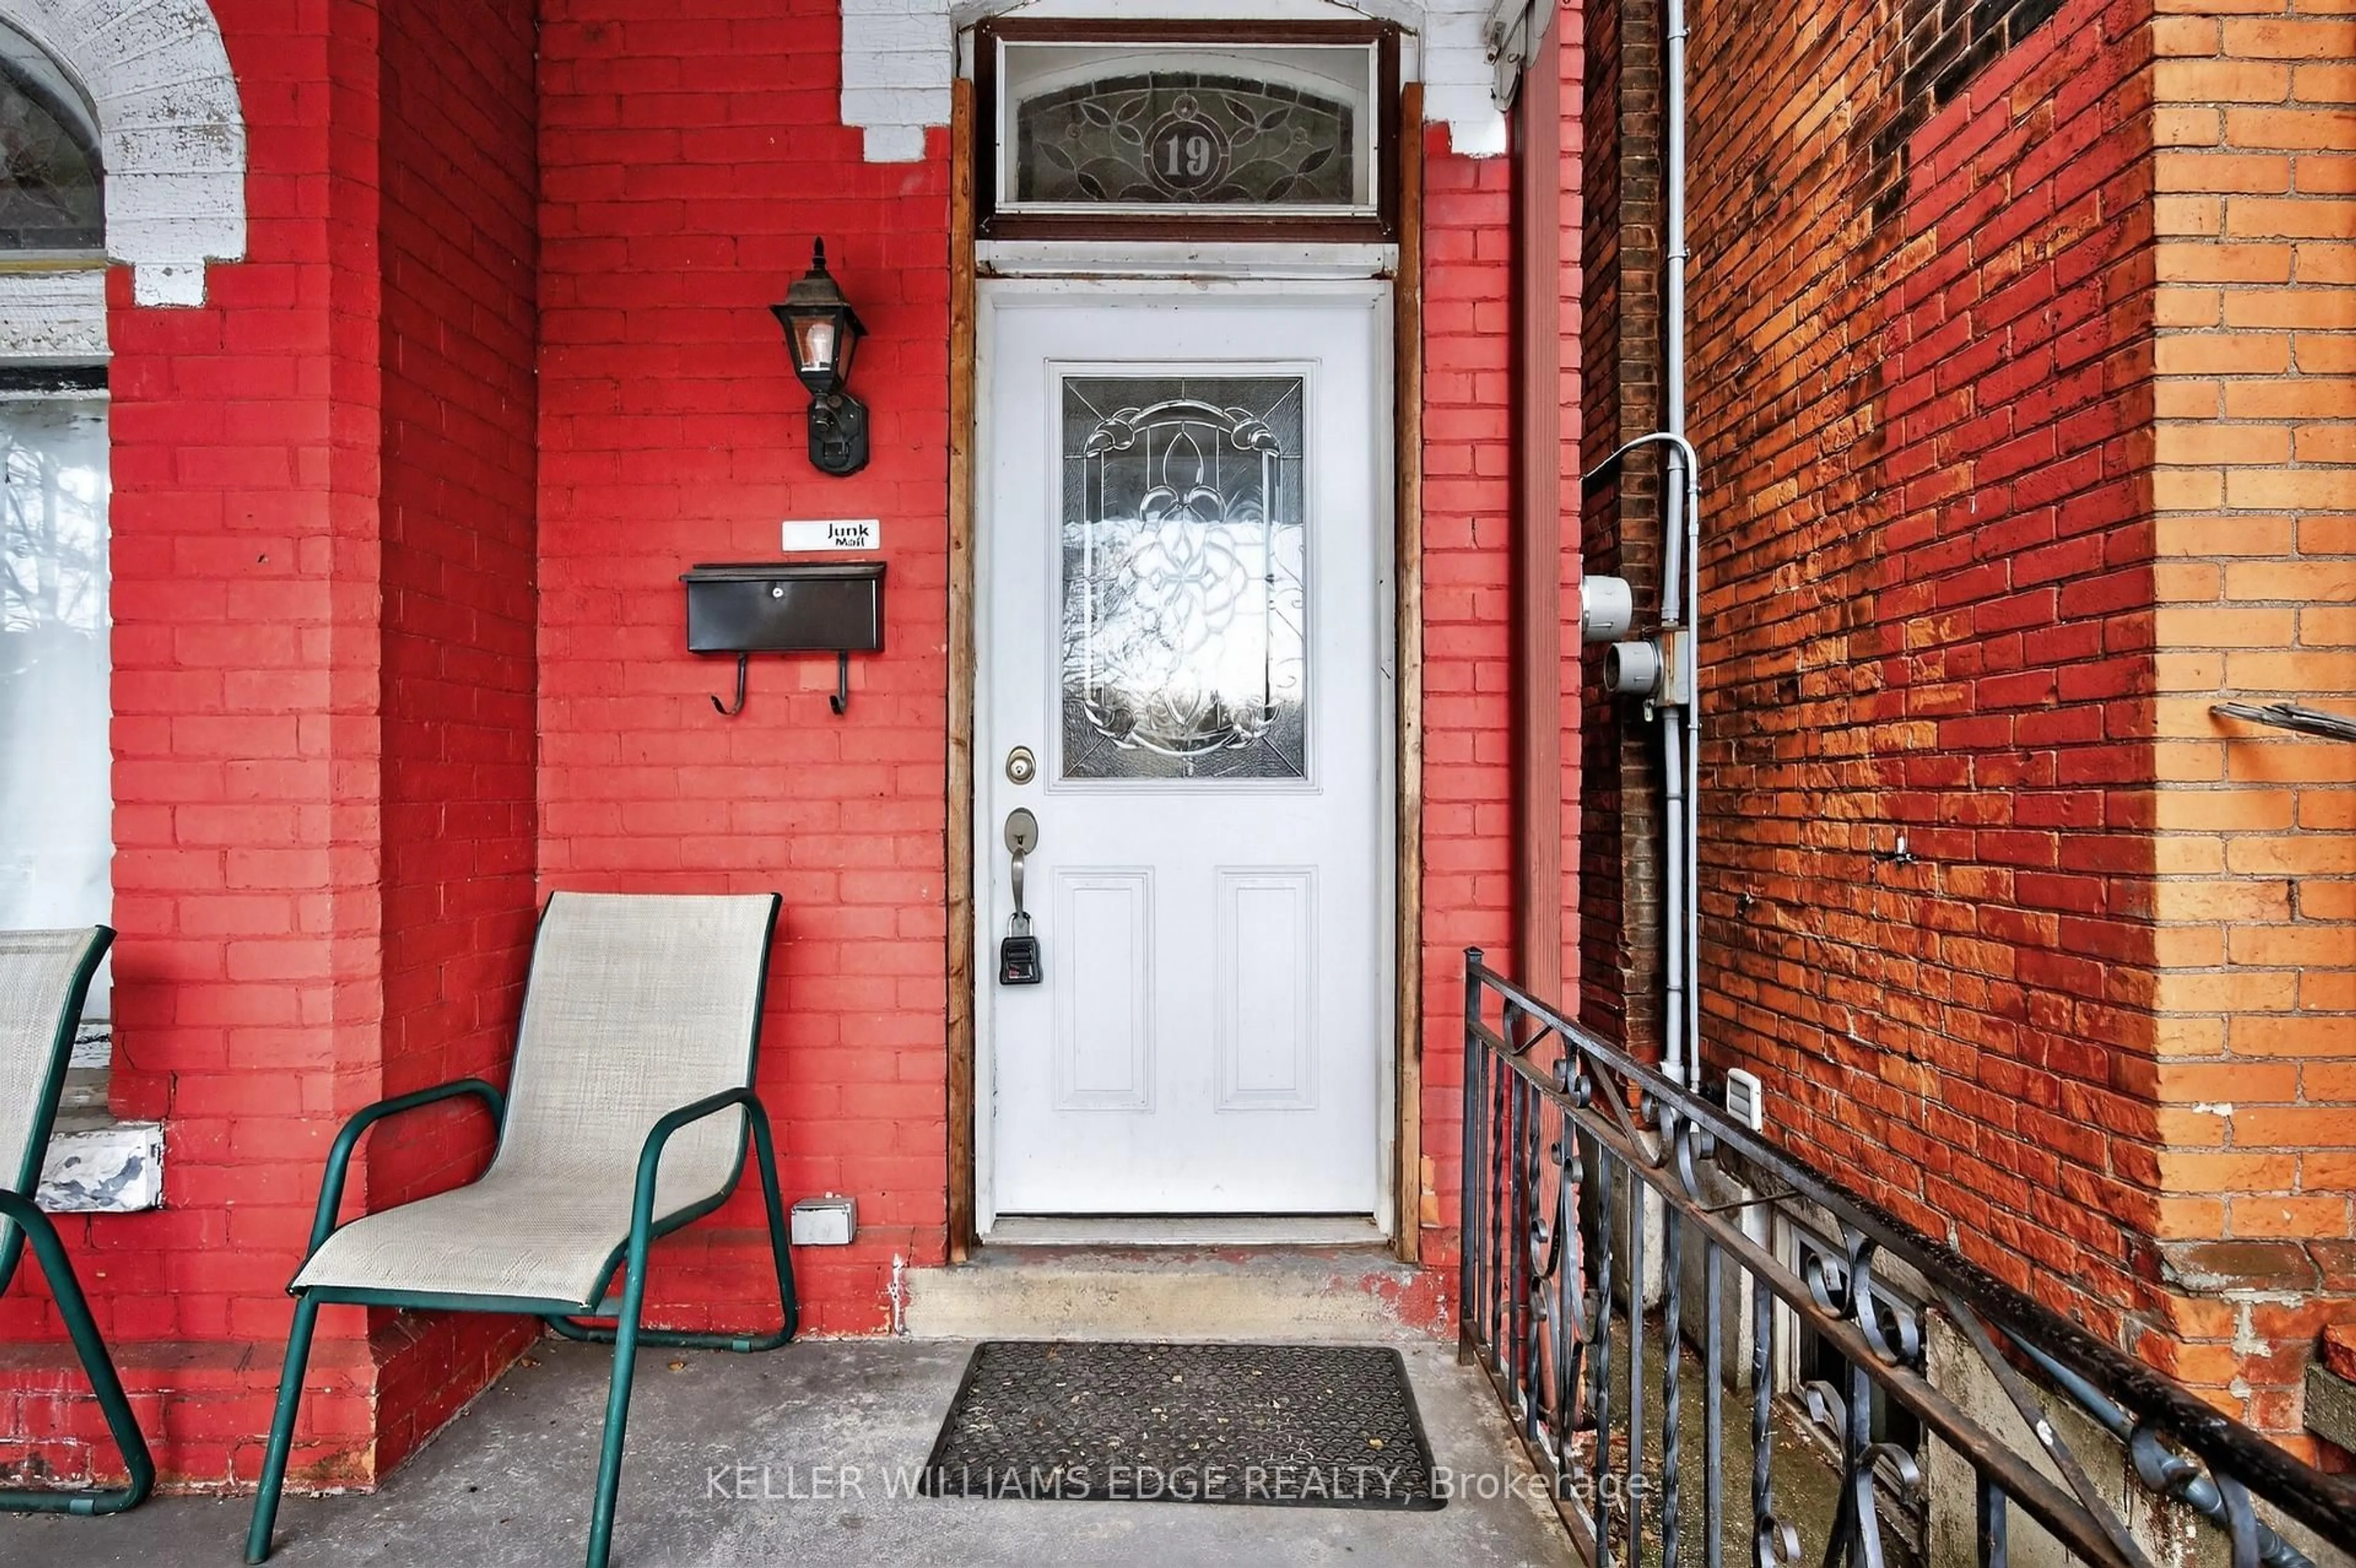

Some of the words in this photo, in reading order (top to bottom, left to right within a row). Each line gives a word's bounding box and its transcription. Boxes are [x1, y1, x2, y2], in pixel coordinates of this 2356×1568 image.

[1165, 134, 1210, 176] 19
[828, 523, 869, 539] Junk
[836, 537, 864, 547] Mail
